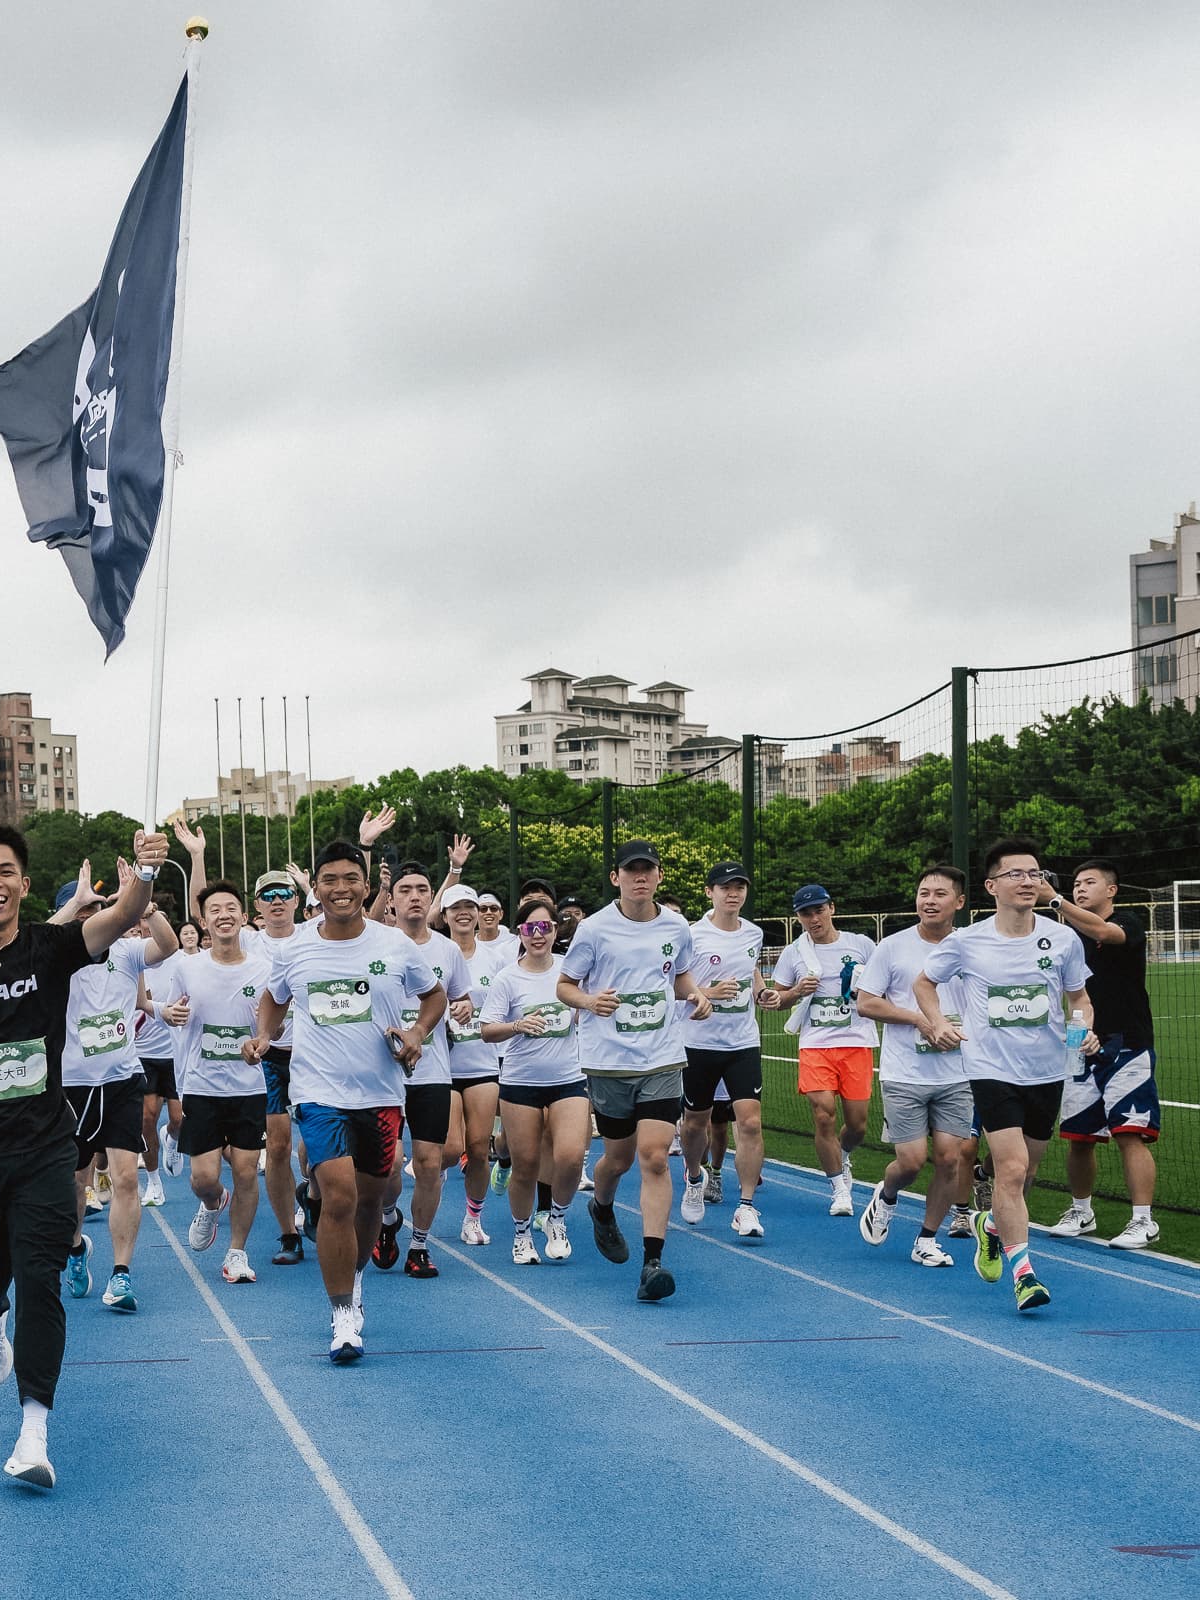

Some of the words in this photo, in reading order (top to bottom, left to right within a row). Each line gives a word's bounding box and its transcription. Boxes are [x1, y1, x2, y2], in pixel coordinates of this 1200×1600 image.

[357, 983, 367, 993] 4
[1007, 1004, 1030, 1013] CWL
[118, 1025, 124, 1034] 2
[214, 1041, 239, 1049] James
